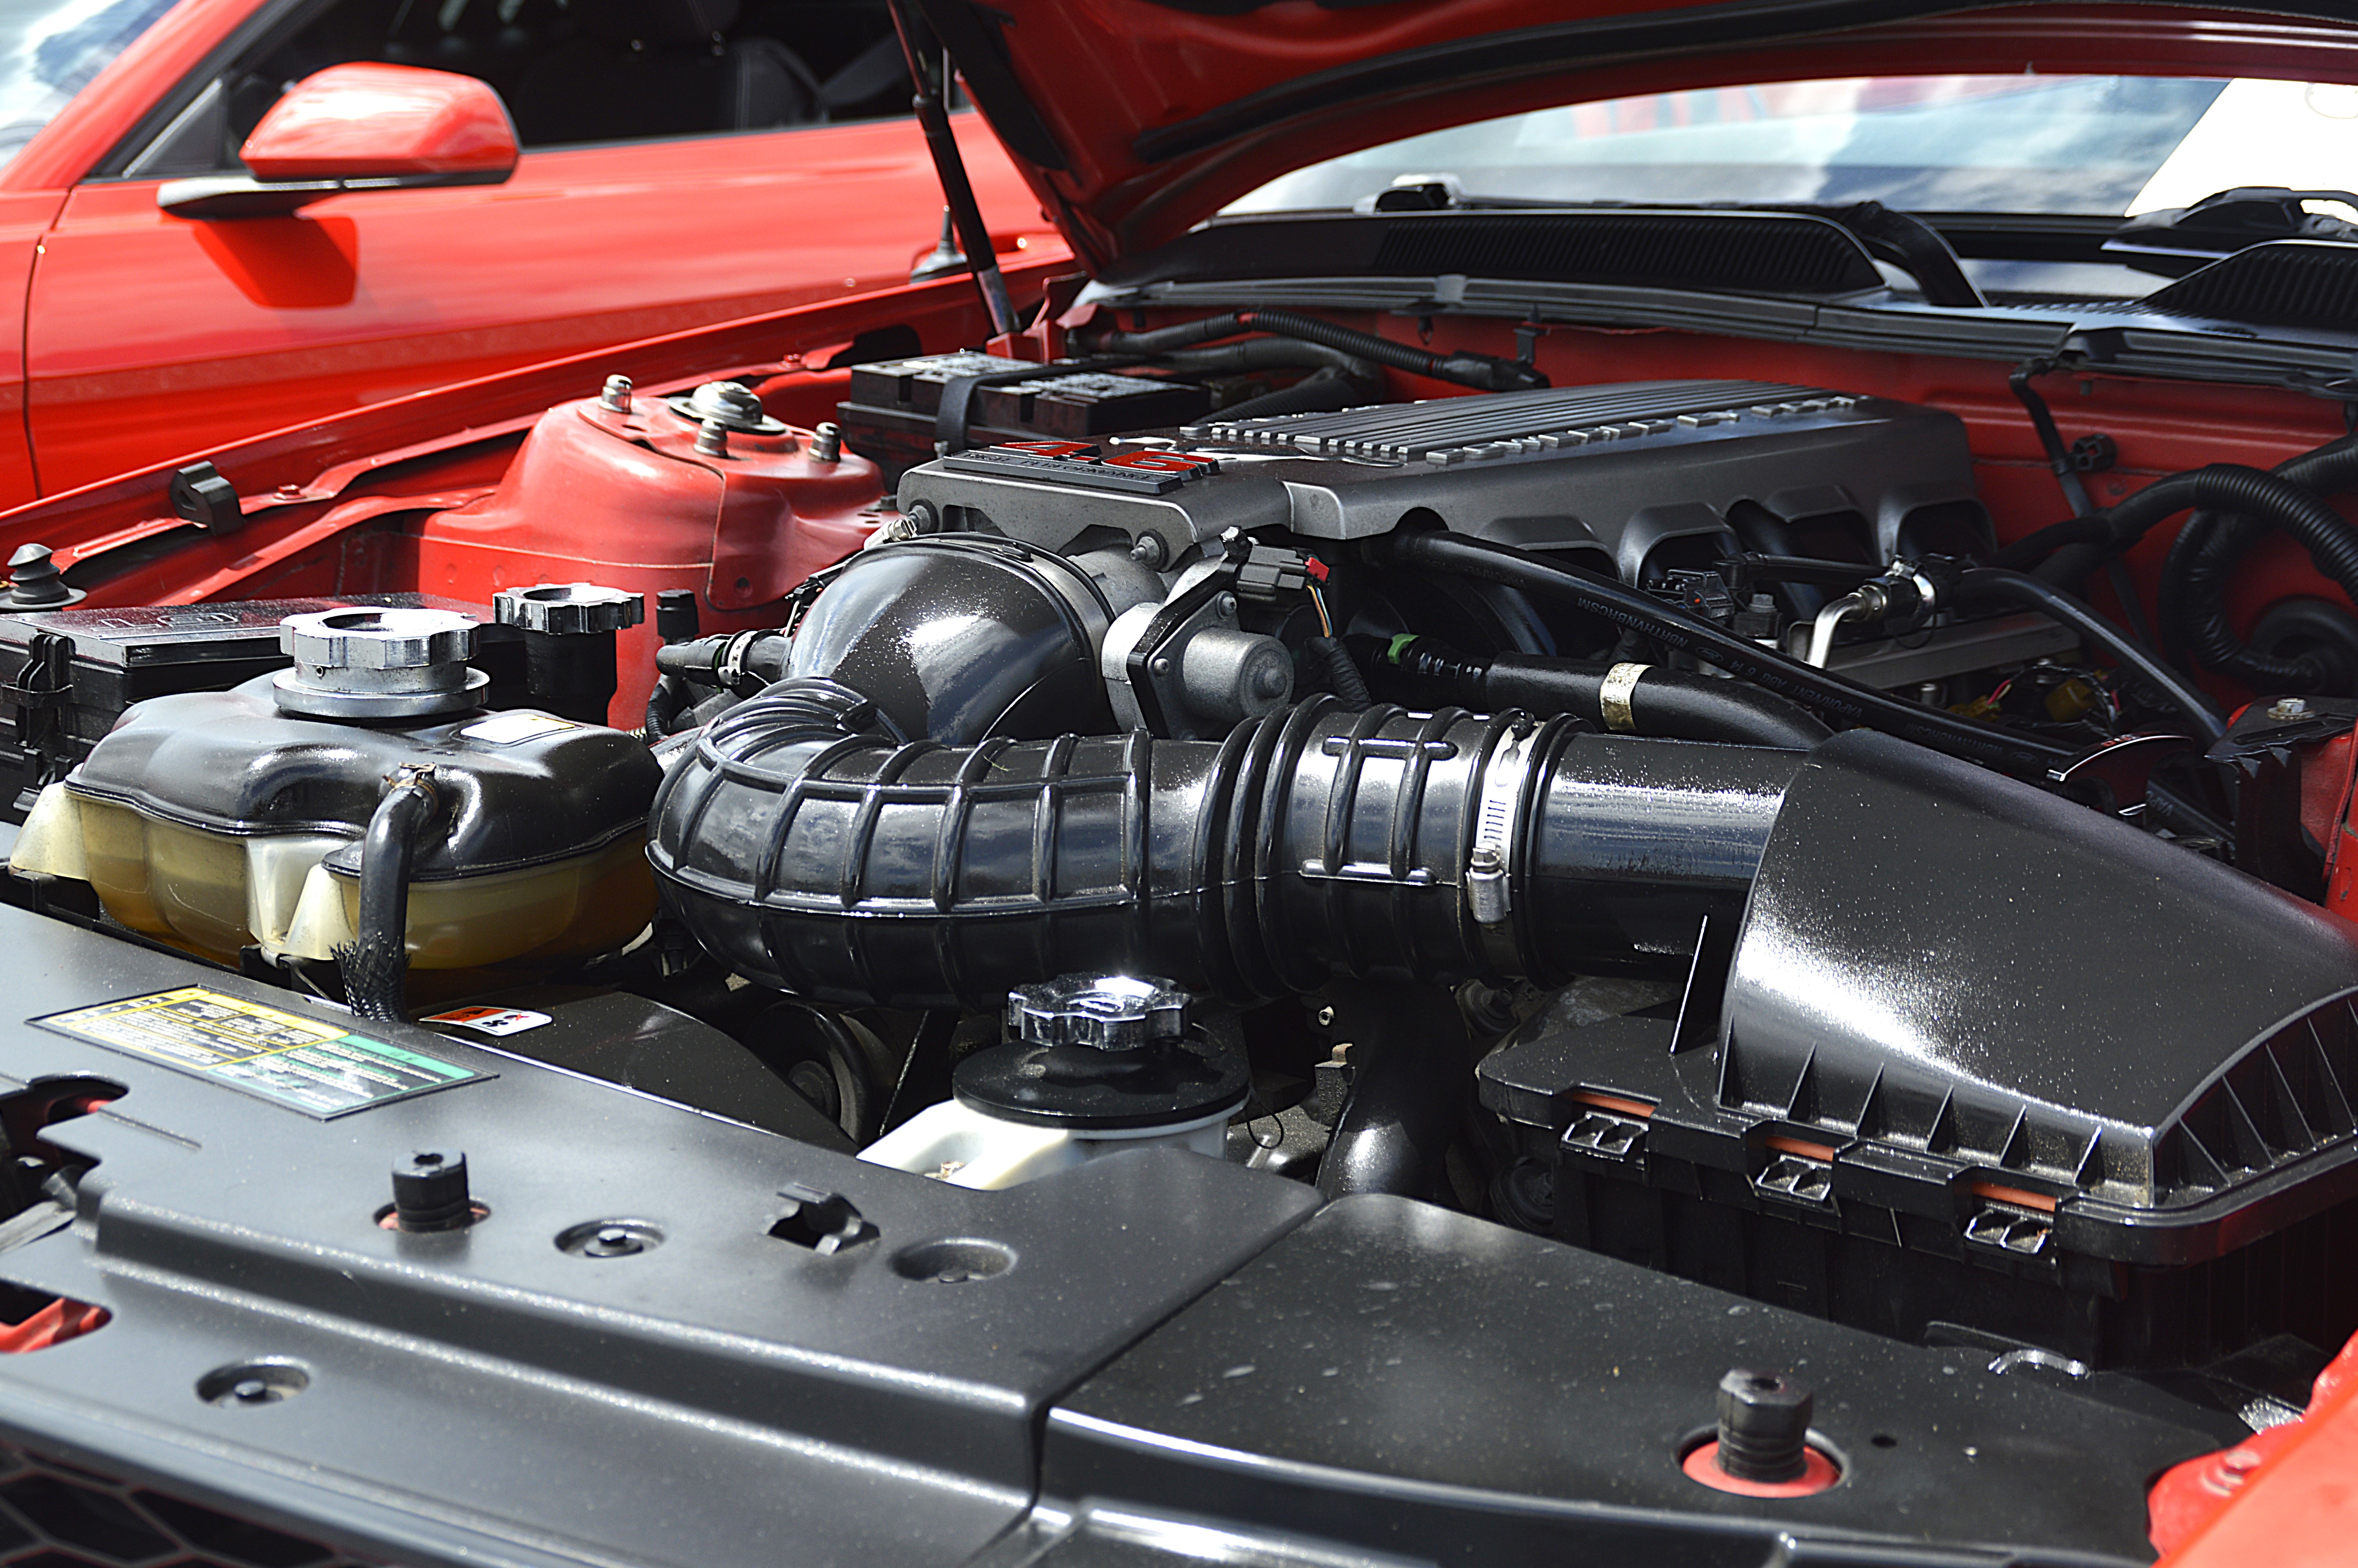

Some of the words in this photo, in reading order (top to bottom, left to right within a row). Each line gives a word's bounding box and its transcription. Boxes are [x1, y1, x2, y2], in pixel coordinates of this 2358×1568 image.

[964, 452, 1010, 462] HIGH
[1021, 460, 1157, 481] PERFORMANCE
[990, 440, 1214, 479] 4.6
[1577, 597, 1688, 648] NBRTHVNBRCSM
[1762, 672, 1788, 688] ABG
[1790, 685, 1863, 718] VAPOR/VENT
